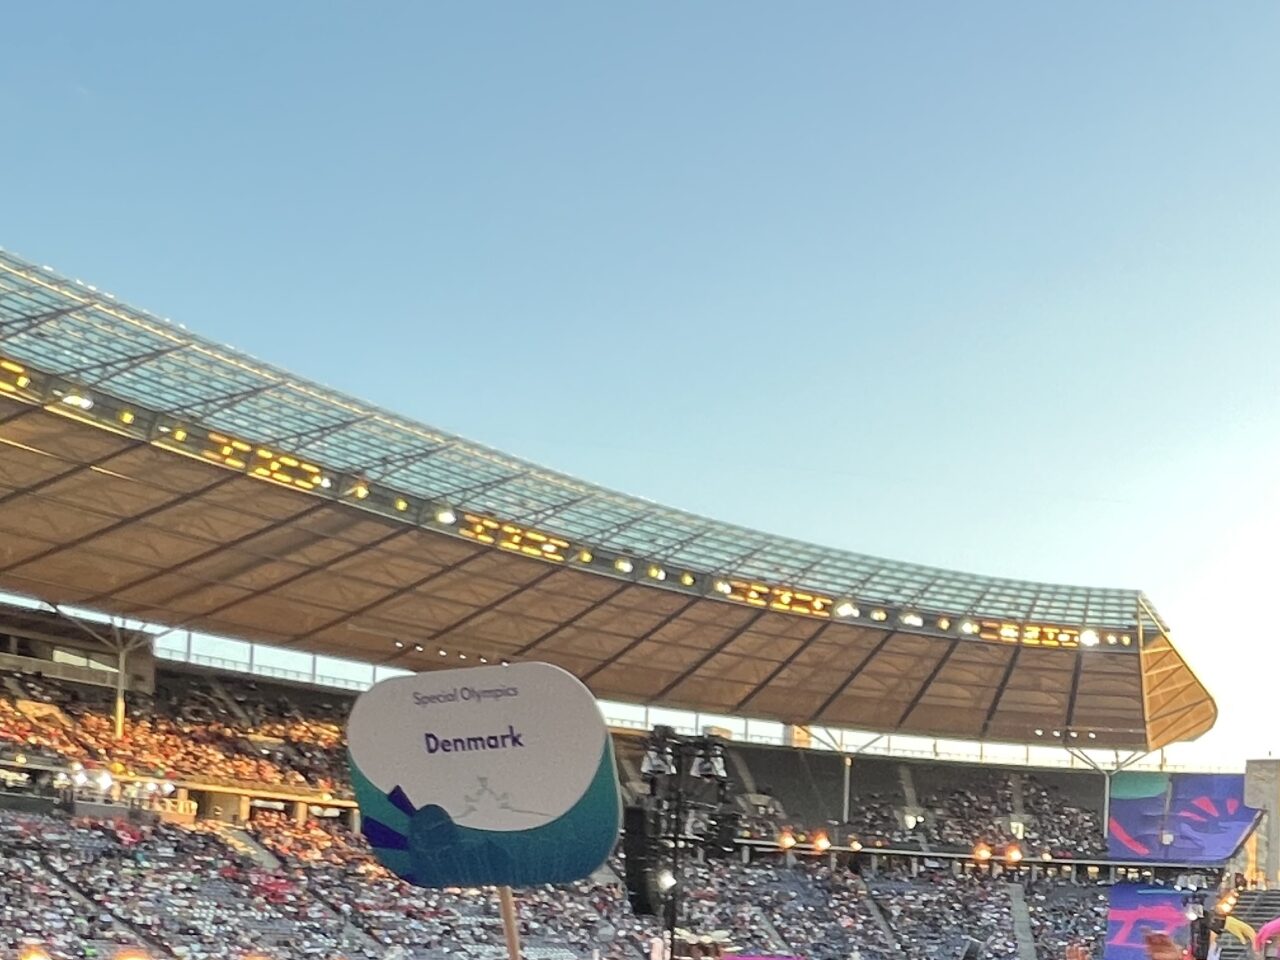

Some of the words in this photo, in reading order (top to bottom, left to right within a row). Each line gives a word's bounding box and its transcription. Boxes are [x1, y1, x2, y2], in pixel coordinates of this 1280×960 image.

[412, 688, 458, 708] Special
[460, 685, 519, 703] Olympics
[424, 724, 524, 754] Denmark
